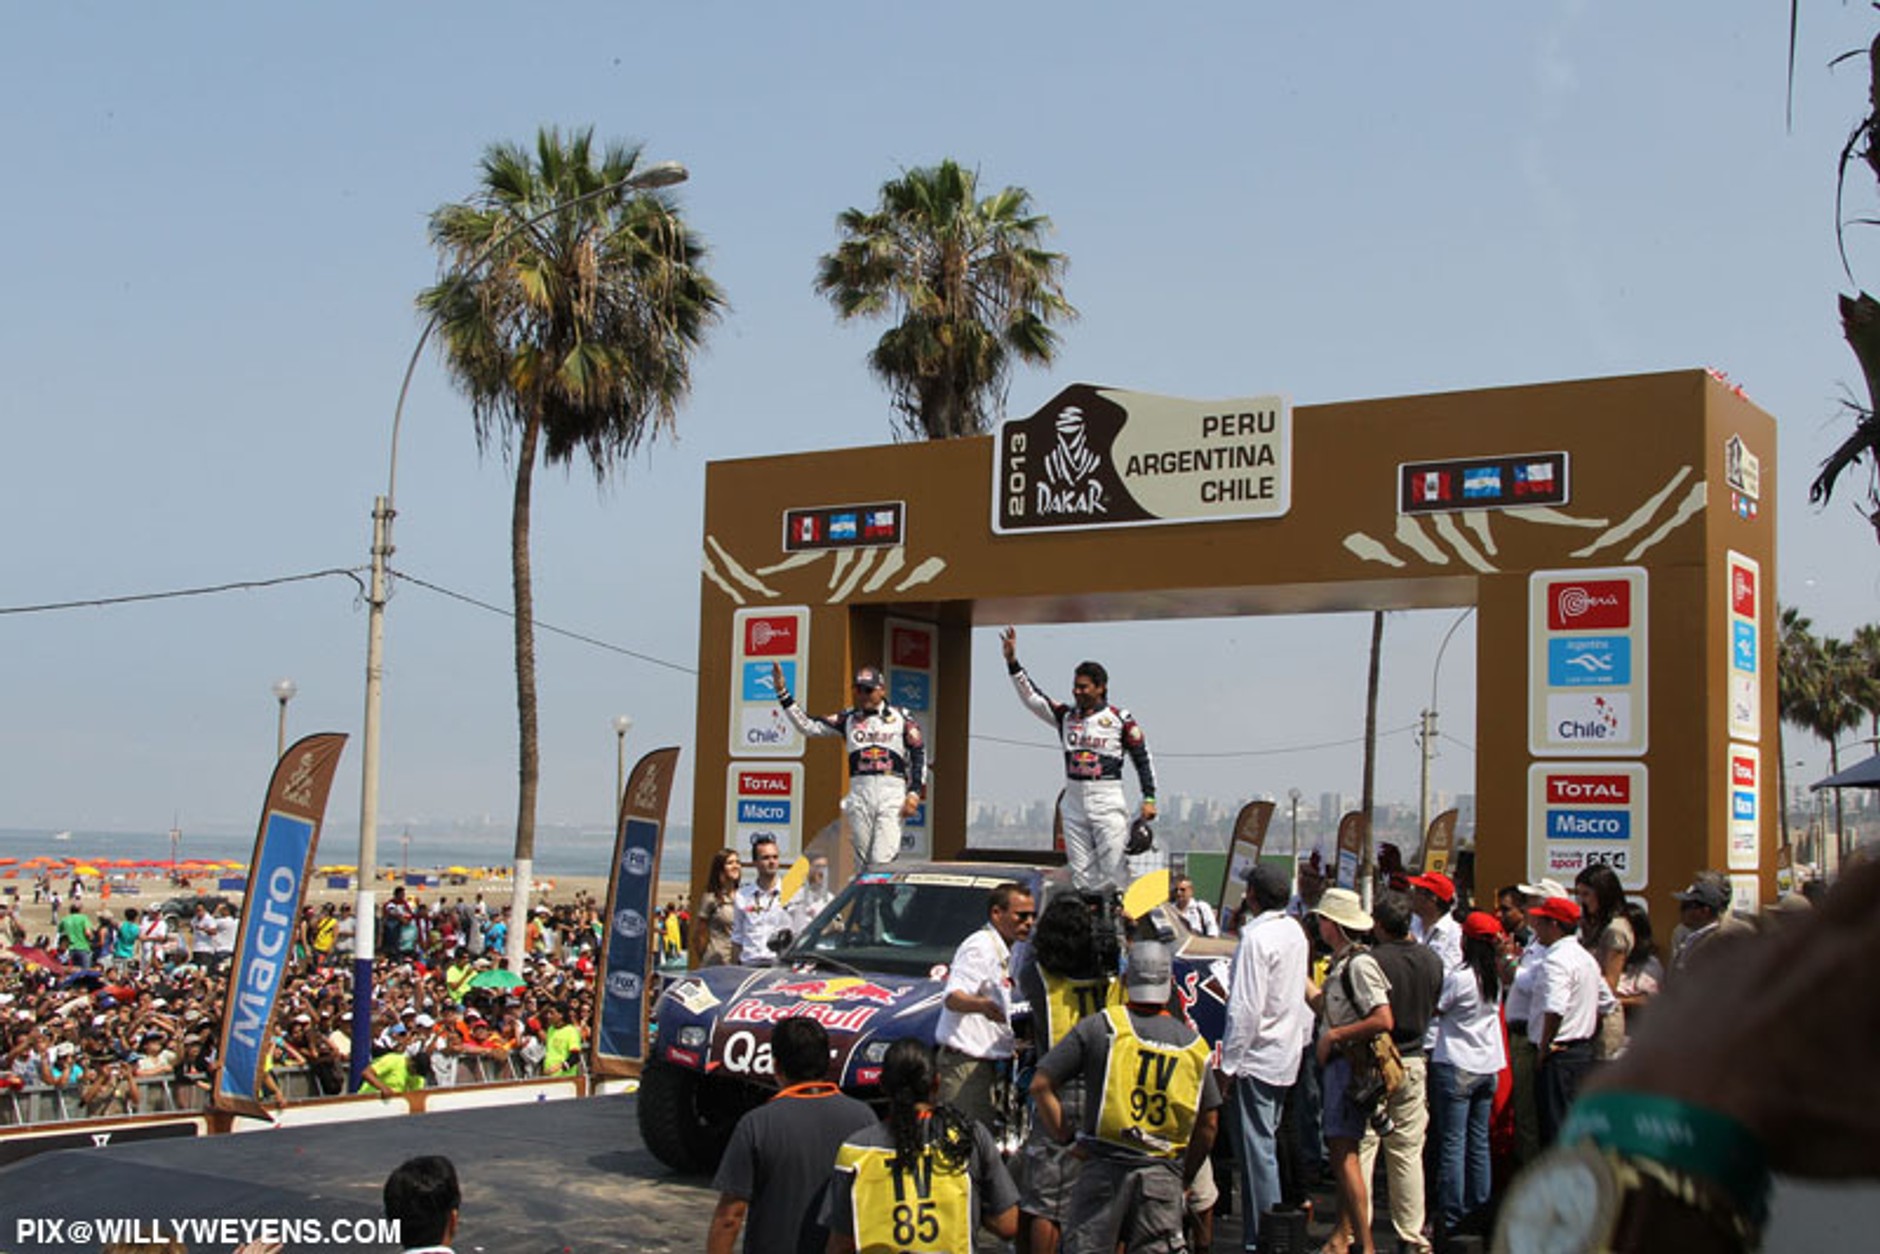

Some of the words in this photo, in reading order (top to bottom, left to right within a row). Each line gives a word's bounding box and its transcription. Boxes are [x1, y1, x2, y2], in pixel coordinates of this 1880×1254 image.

[1202, 411, 1276, 438] PERU
[1009, 432, 1027, 516] 2013
[1125, 444, 1276, 477] ARGENTINA
[1036, 479, 1107, 516] DAKAR
[1200, 476, 1275, 503] CHILE
[747, 728, 779, 743] Chile
[853, 730, 895, 743] Qatar
[1558, 720, 1607, 738] Chile
[742, 776, 788, 790] TOTAL
[1552, 780, 1625, 797] TOTAL
[743, 804, 785, 818] Macro
[1556, 814, 1620, 833] Macro
[1551, 858, 1583, 870] sport
[232, 866, 296, 1049] Macro
[616, 976, 636, 988] FOX
[723, 998, 803, 1022] Red
[801, 1002, 880, 1032] Bull
[1136, 1050, 1179, 1092] TV
[1130, 1088, 1168, 1126] 93
[883, 1157, 933, 1202] TV
[893, 1203, 939, 1246] 85
